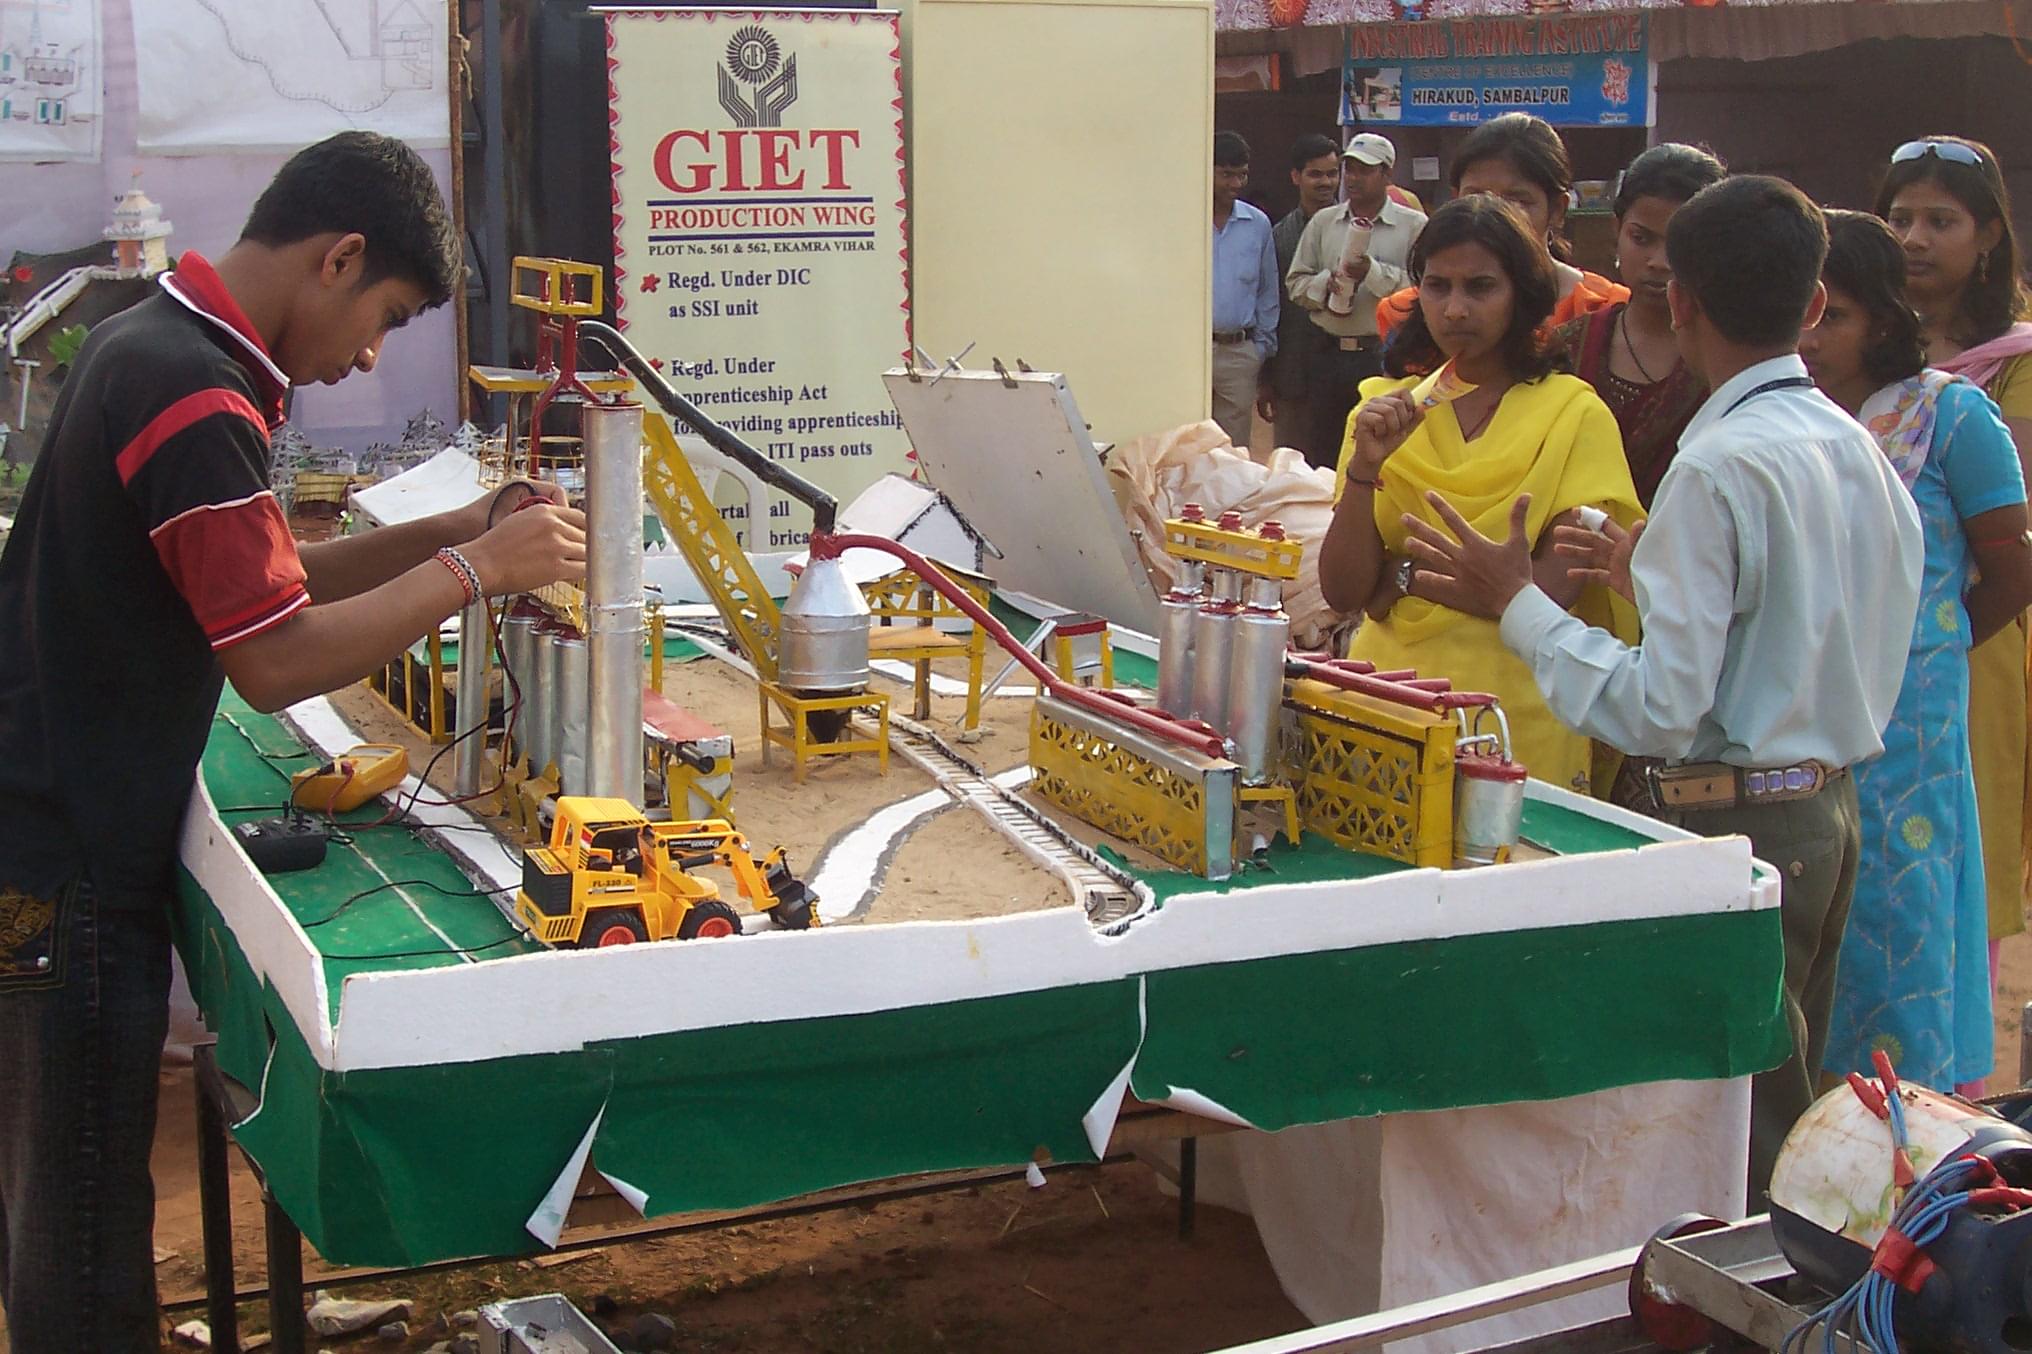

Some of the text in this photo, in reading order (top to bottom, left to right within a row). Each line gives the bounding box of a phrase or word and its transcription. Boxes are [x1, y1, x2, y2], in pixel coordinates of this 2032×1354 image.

[1412, 86, 1569, 107] HIRAKUD, SAMBALPUR
[653, 129, 860, 194] GIET
[650, 206, 876, 229] PRODUCTION WING
[649, 240, 875, 256] PLOT No. 561 & 562, EKAMRA VIHAR
[668, 268, 811, 292] Regd. Under DIC
[669, 299, 759, 318] as SSI unit
[671, 357, 776, 379] Regd. Under
[799, 384, 827, 400] Act
[768, 441, 873, 462] ITI pass outs
[769, 501, 790, 517] all
